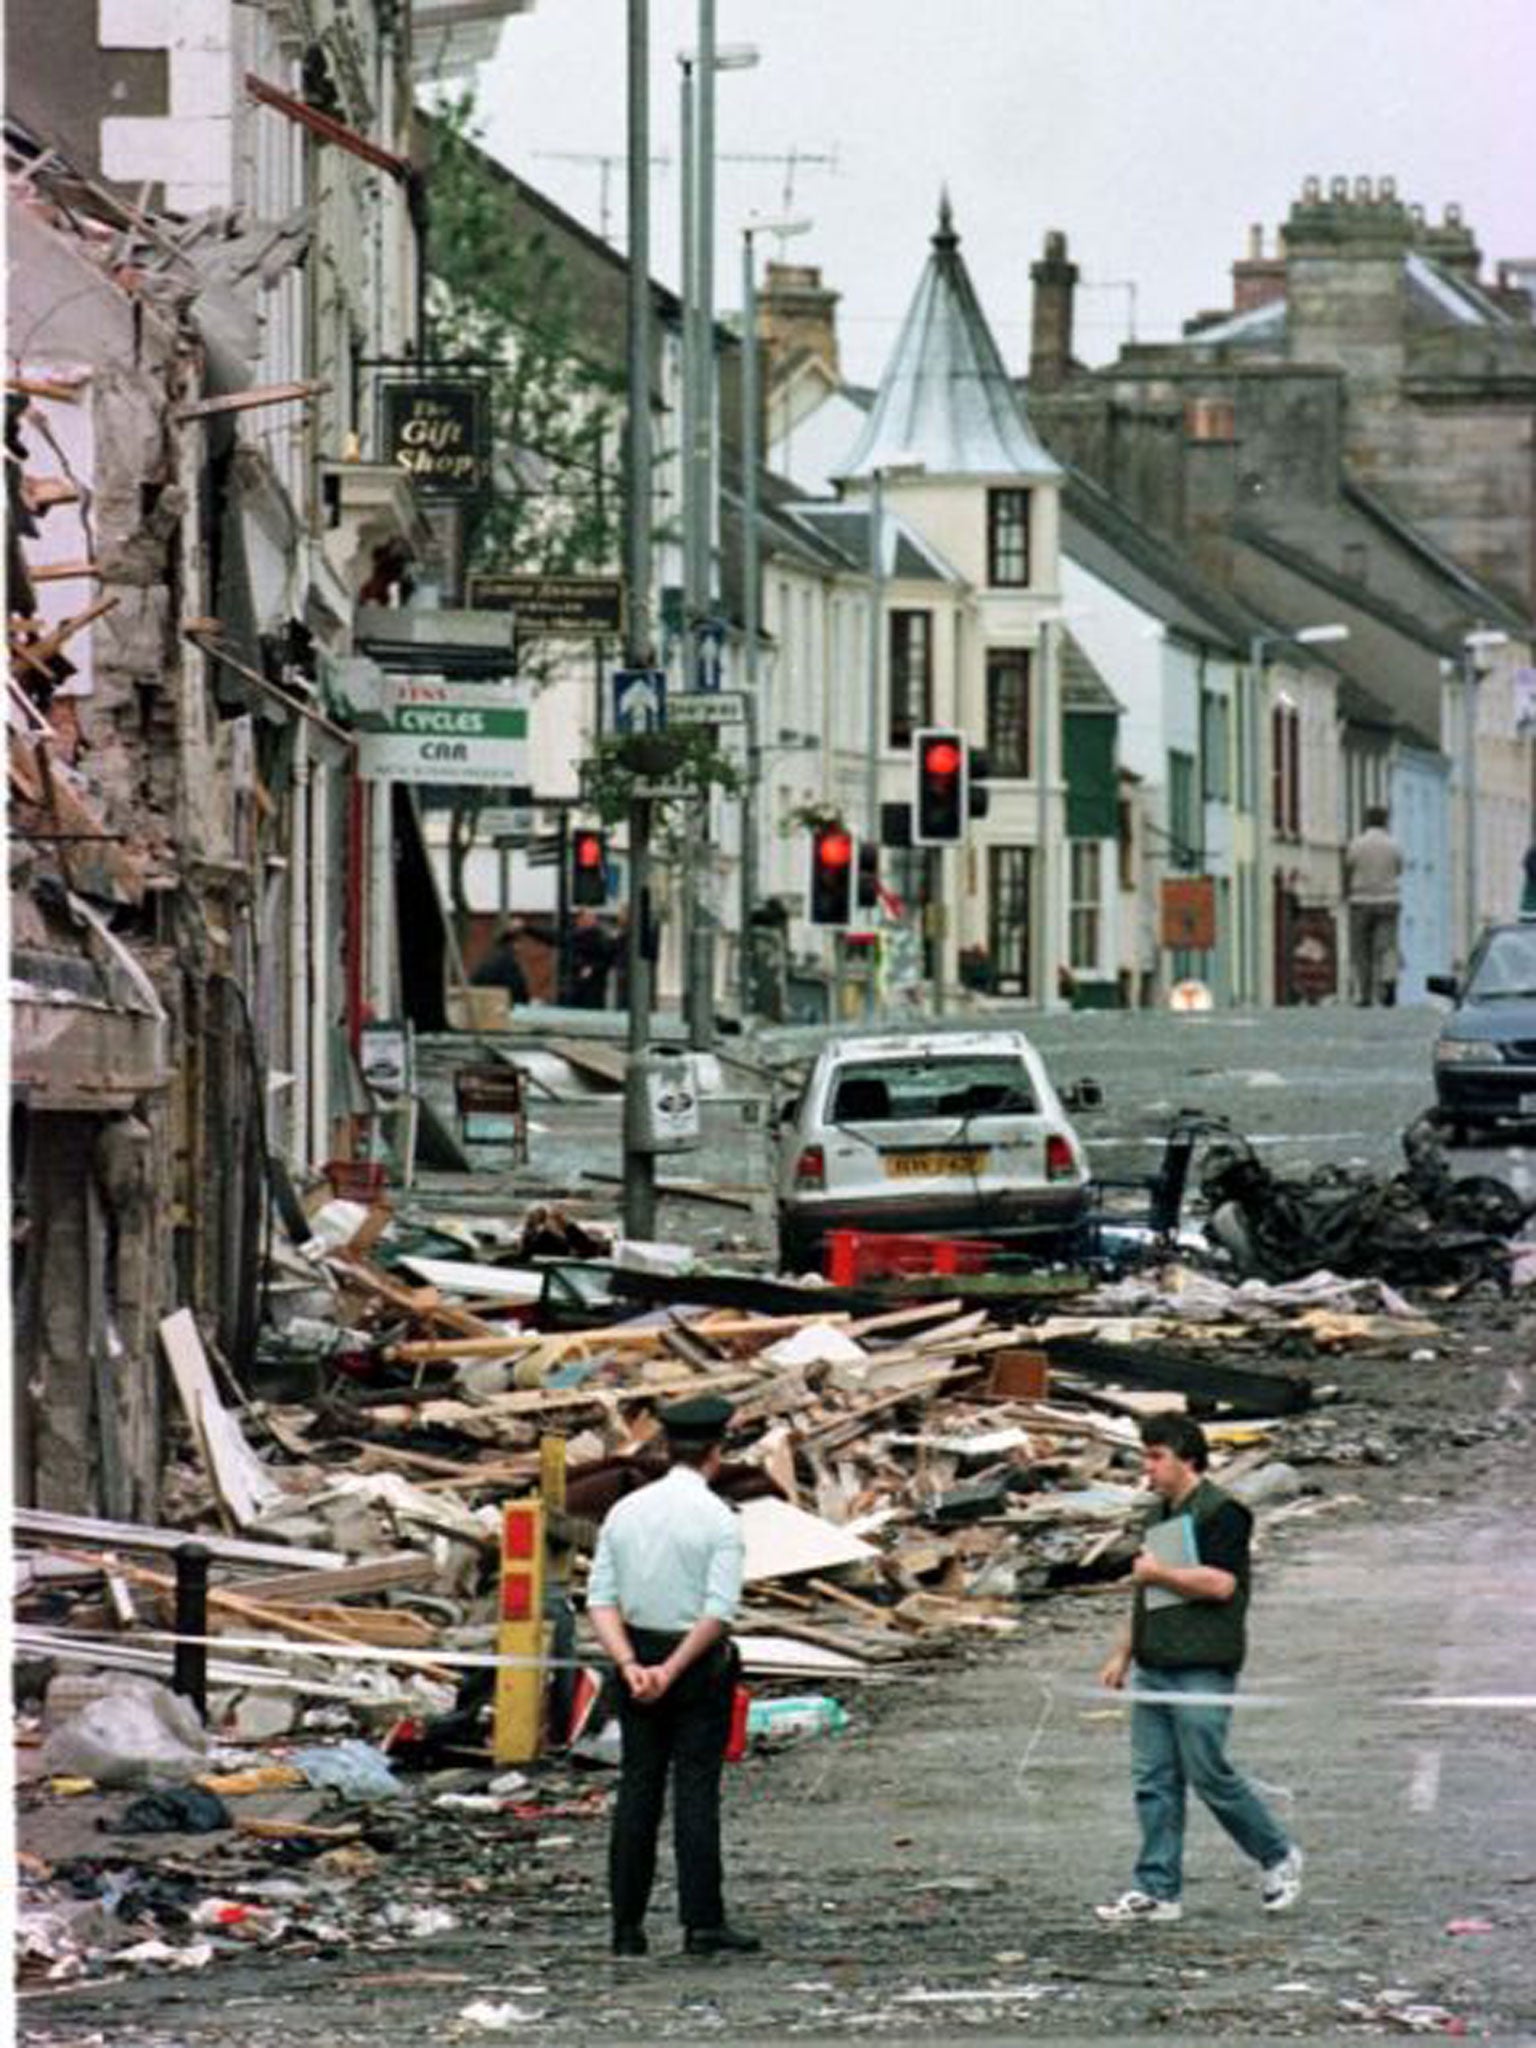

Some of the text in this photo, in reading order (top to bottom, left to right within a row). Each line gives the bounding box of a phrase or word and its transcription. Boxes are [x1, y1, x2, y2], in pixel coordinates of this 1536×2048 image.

[401, 420, 462, 450] Gift
[396, 449, 473, 477] Shop
[401, 711, 485, 732] CYCLES
[419, 742, 468, 761] CAR
